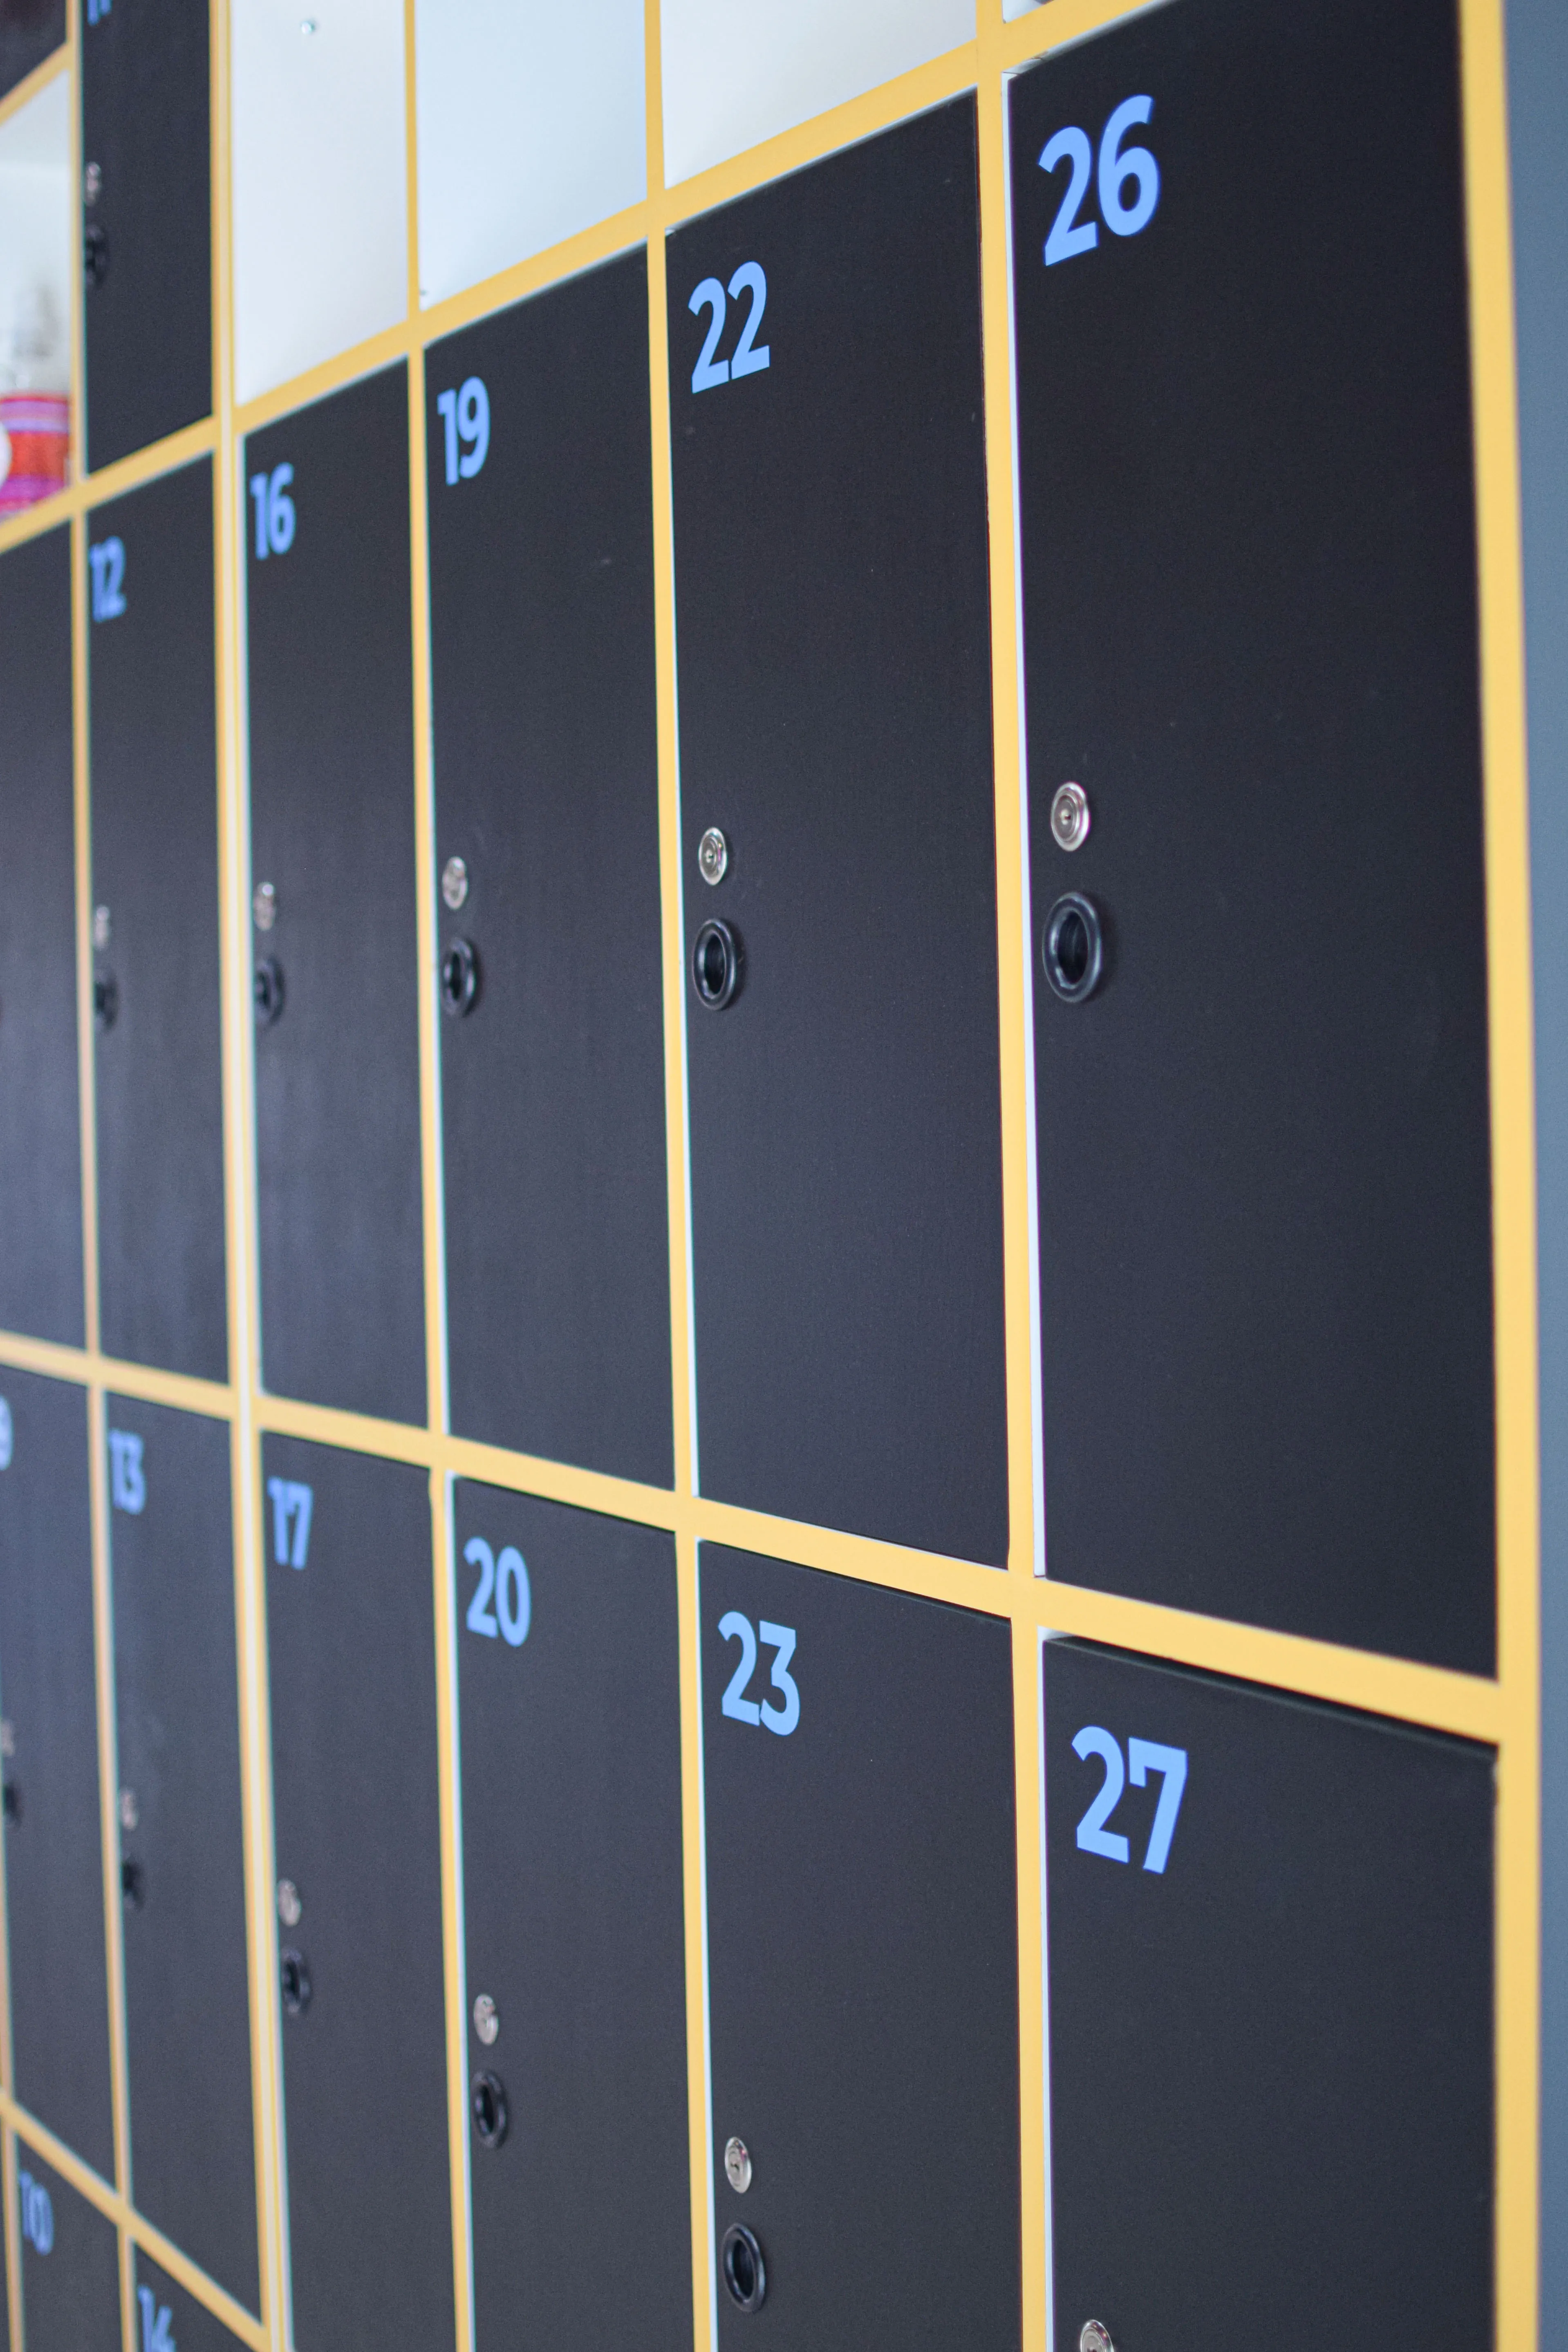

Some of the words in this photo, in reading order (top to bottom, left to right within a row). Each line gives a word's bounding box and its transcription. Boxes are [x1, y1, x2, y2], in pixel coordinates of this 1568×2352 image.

[1039, 95, 1160, 265] 26
[689, 262, 769, 392] 22
[438, 377, 489, 485] 19
[251, 463, 294, 559] 16
[89, 537, 126, 621] 12
[108, 1428, 146, 1514] 13
[267, 1476, 314, 1570] 17
[464, 1537, 531, 1646] 20
[719, 1612, 800, 1735] 23
[1072, 1726, 1188, 1873] 27
[19, 2171, 54, 2254] 10
